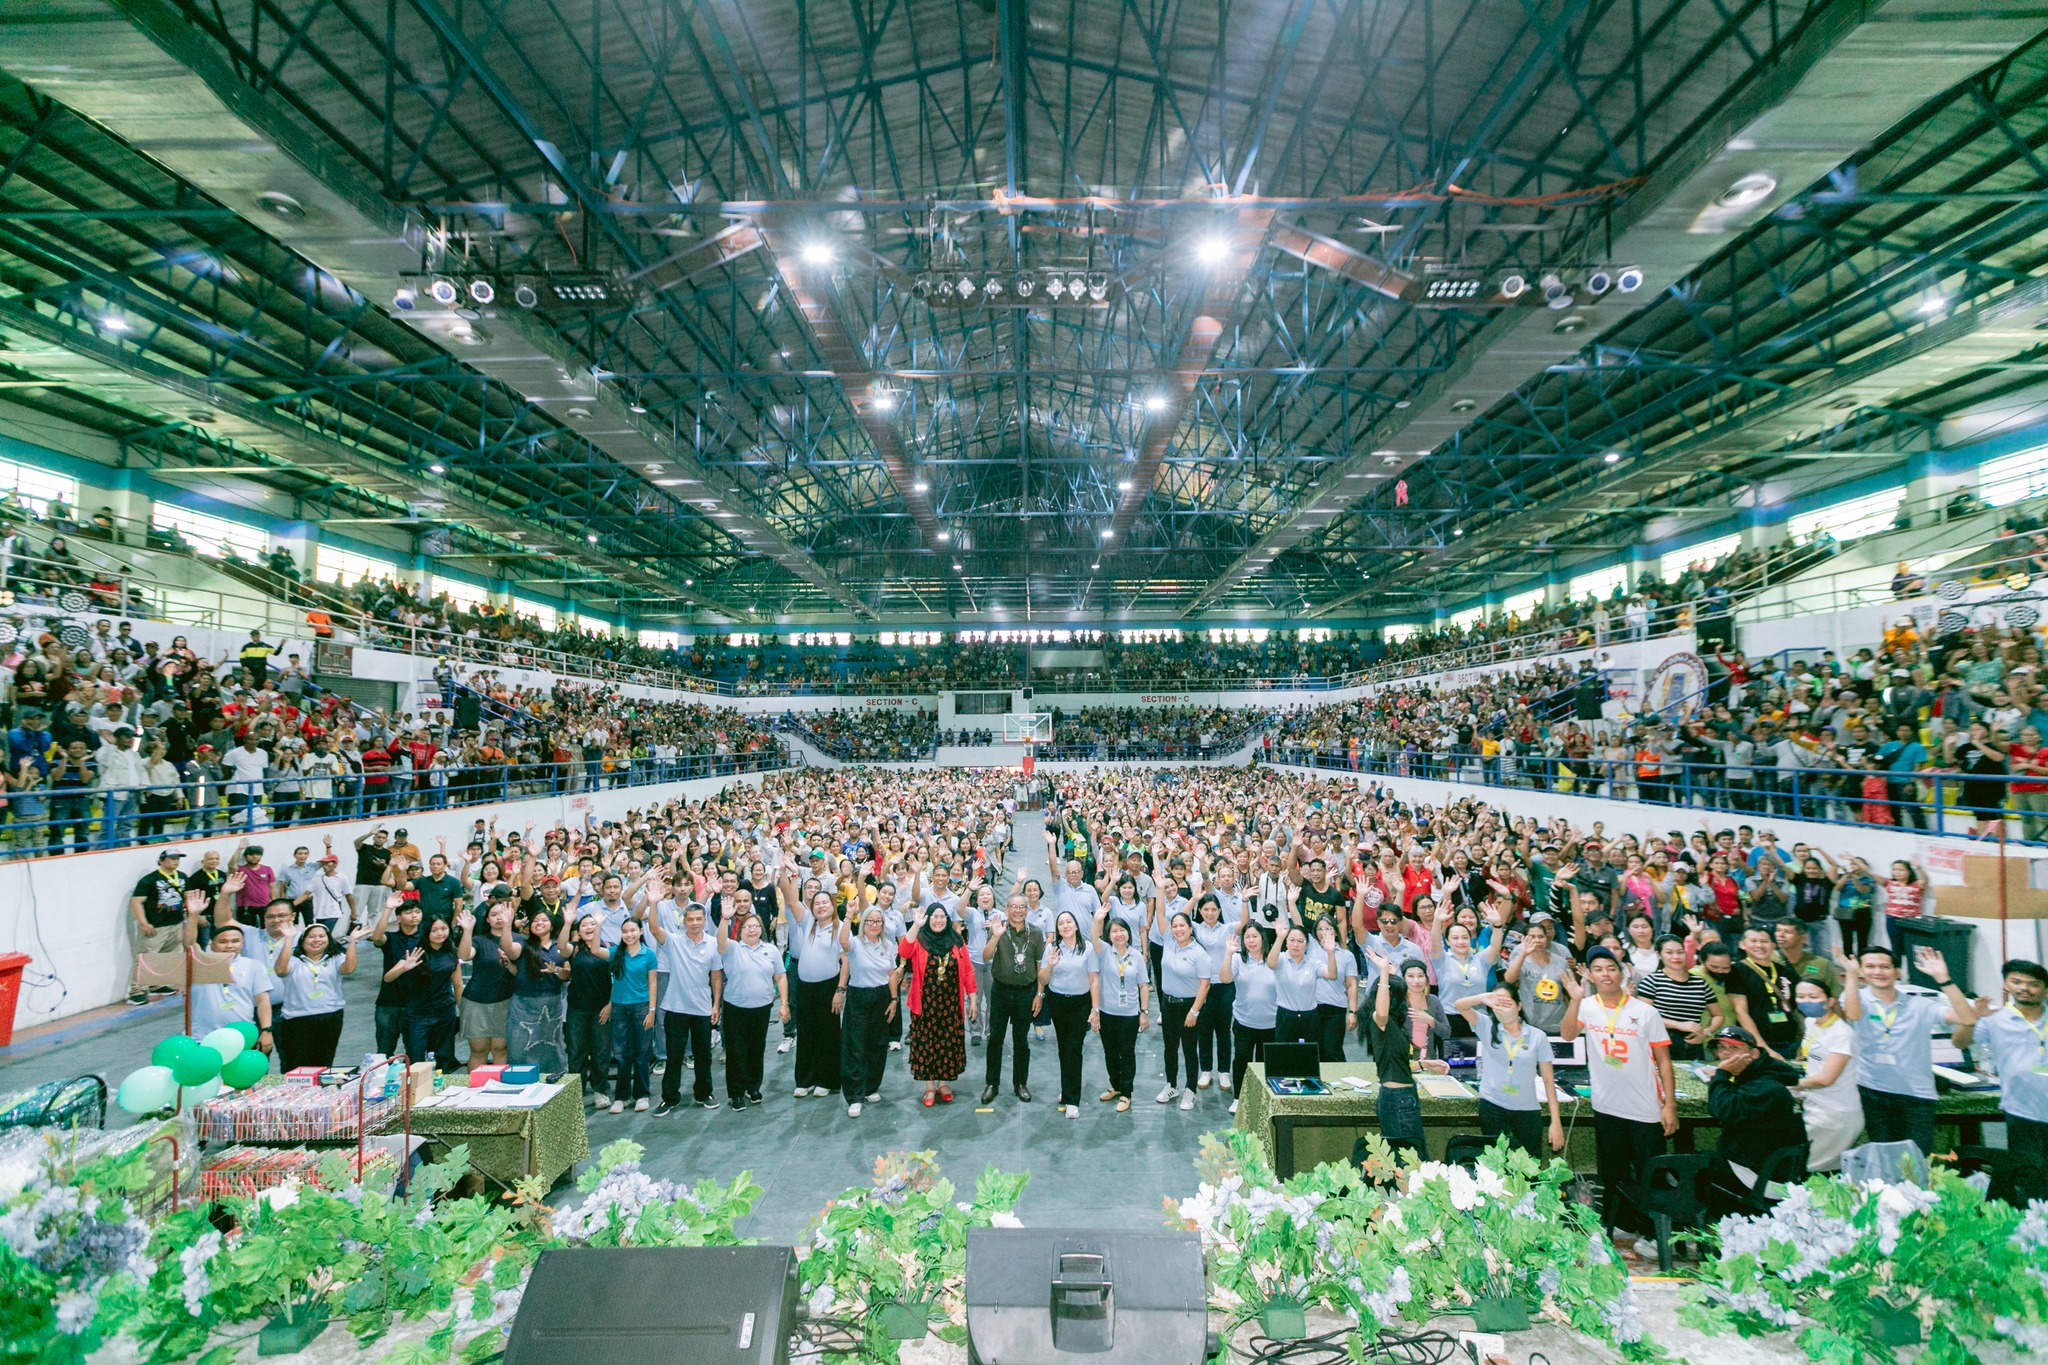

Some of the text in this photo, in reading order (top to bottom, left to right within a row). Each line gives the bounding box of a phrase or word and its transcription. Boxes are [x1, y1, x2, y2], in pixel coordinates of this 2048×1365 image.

[866, 698, 903, 706] SECTION
[911, 698, 918, 706] C
[1141, 695, 1177, 703] SECTION
[1183, 695, 1190, 703] C
[1589, 1024, 1638, 1036] POLOOLOK
[1601, 1038, 1629, 1064] 12
